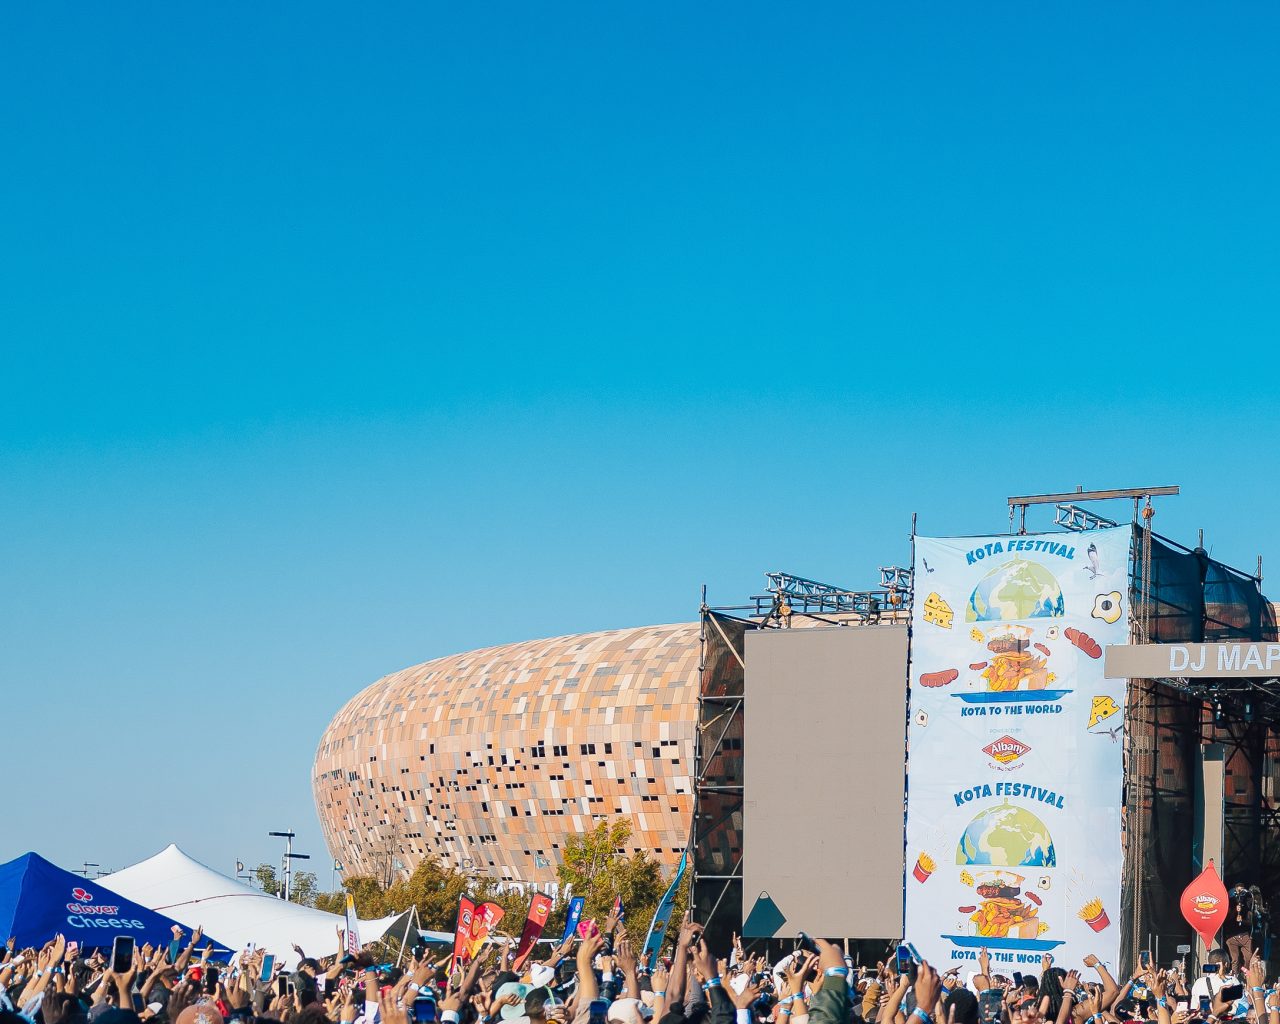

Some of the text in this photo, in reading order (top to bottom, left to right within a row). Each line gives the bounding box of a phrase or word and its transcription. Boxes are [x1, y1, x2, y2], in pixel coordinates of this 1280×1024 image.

[965, 540, 1076, 566] KOTA FESTIVAL
[1169, 645, 1207, 672] DJ
[961, 704, 1063, 717] KOTA TO THE WORLD
[991, 742, 1025, 755] Albany
[953, 782, 1065, 810] KOTA FESTIVAL
[1195, 895, 1218, 905] Albany
[66, 902, 119, 915] Clover
[67, 915, 146, 929] Cheese
[951, 949, 1055, 964] KOTA O THE WOR
